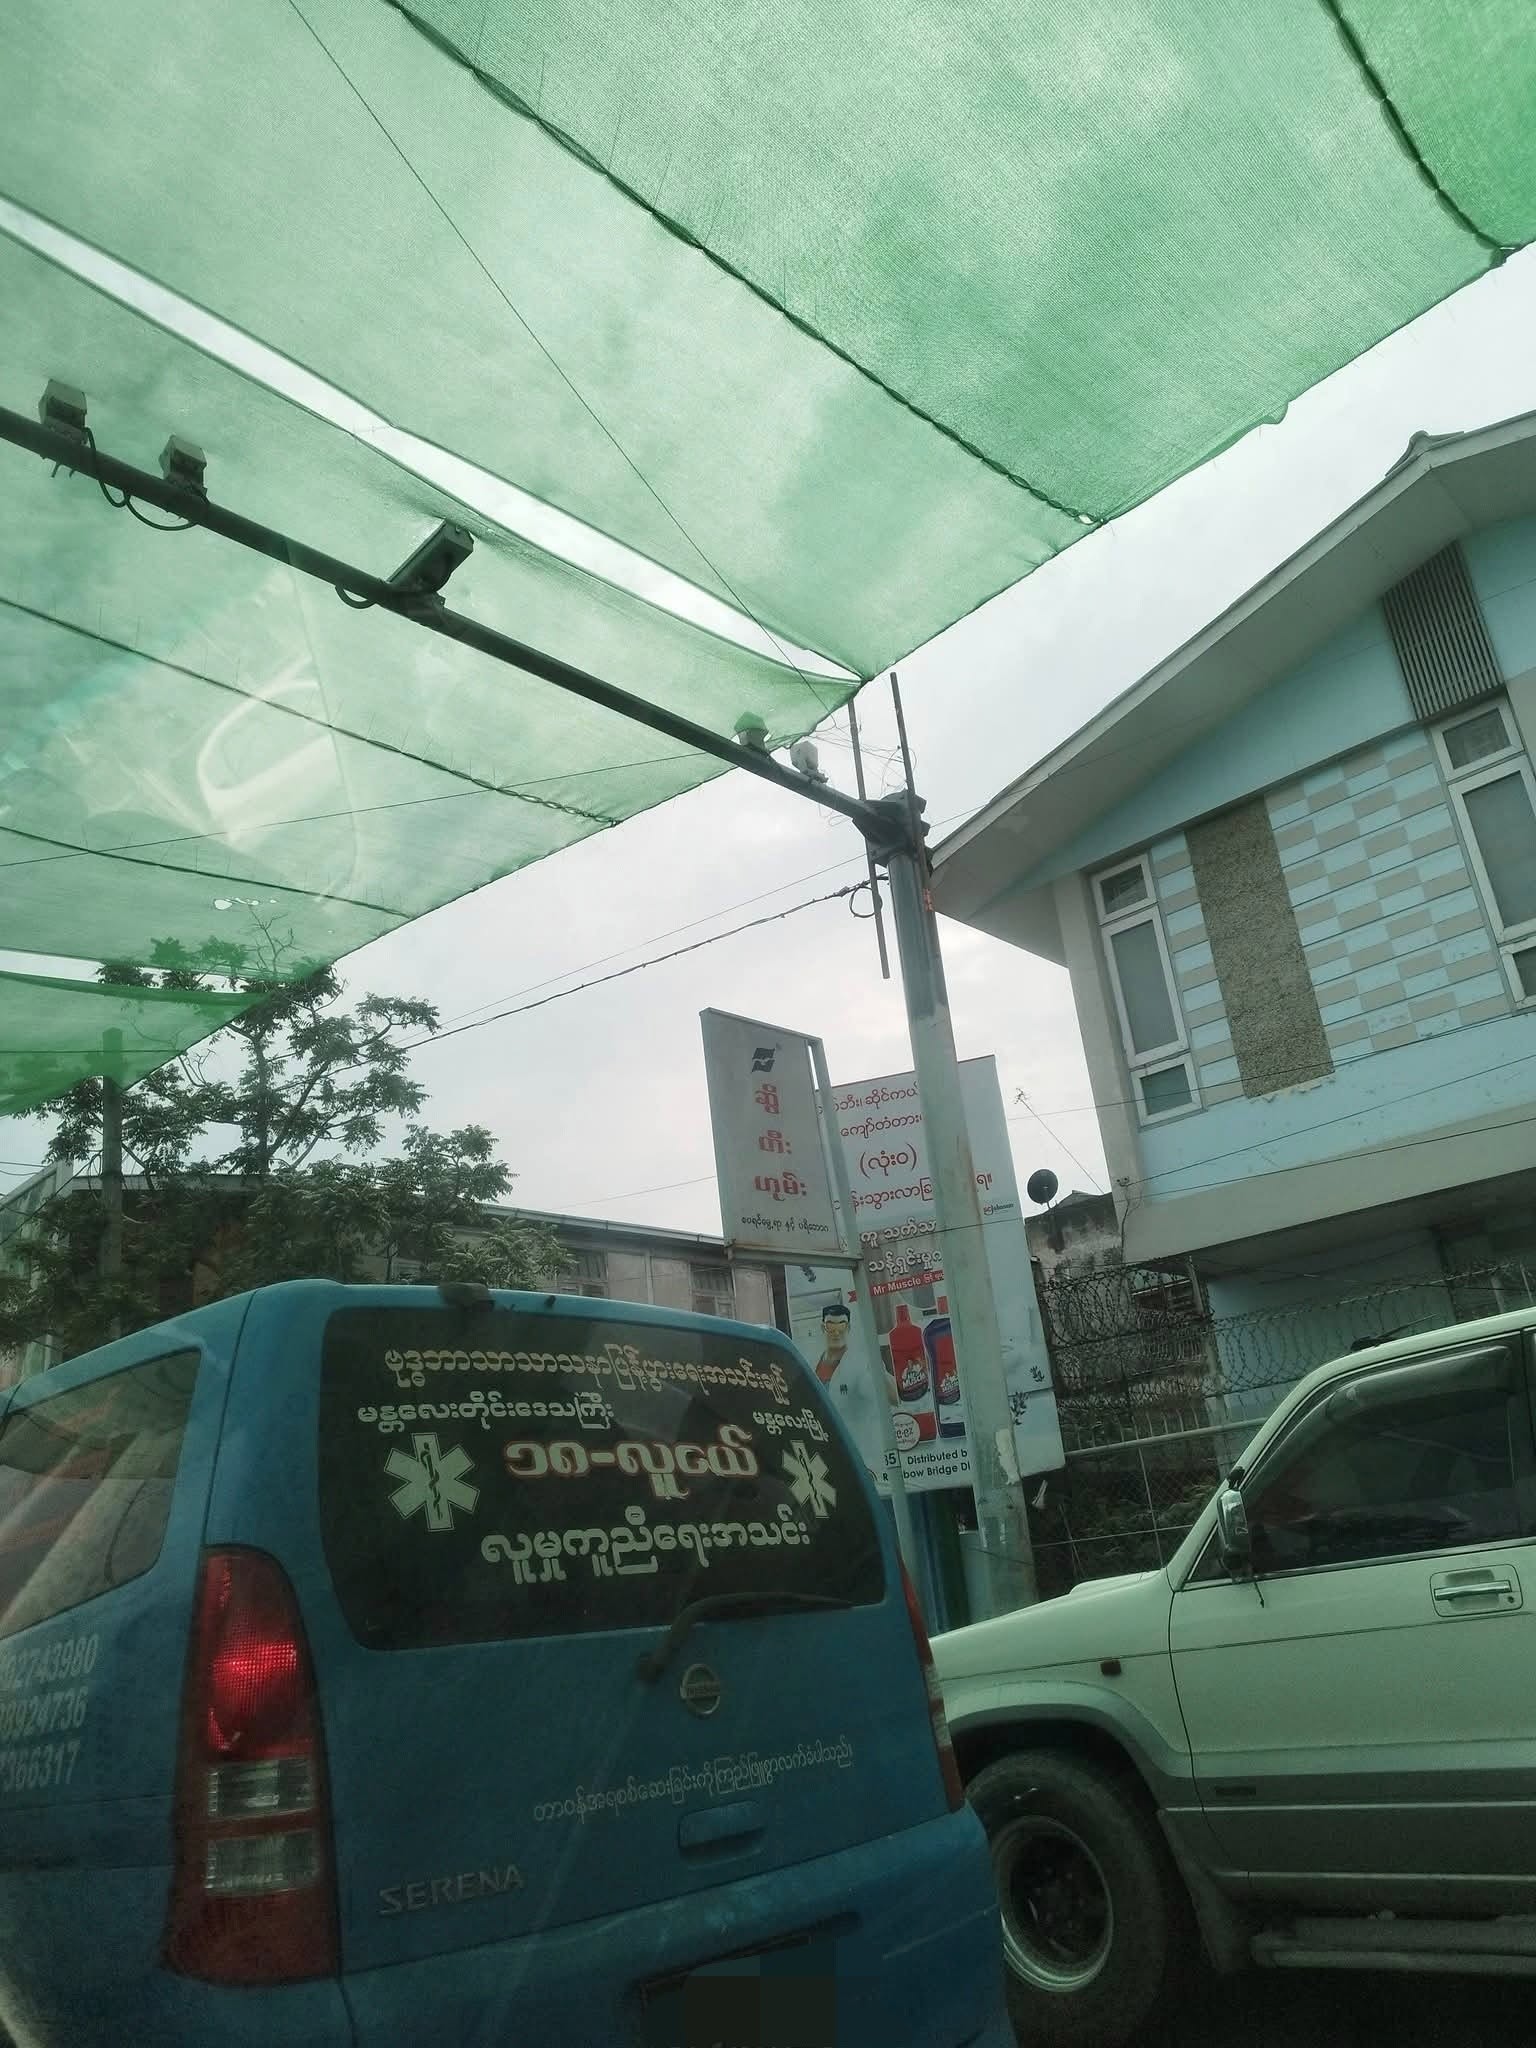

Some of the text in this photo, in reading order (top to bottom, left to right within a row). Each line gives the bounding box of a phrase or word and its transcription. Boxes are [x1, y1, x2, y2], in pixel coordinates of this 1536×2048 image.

[859, 1143, 918, 1180] (လုံးဝ)
[872, 1285, 886, 1296] Mr
[887, 1277, 921, 1293] Muscle
[907, 1450, 957, 1465] Distributed
[926, 1463, 958, 1475] Bridge
[378, 1864, 526, 1919] SERENA
